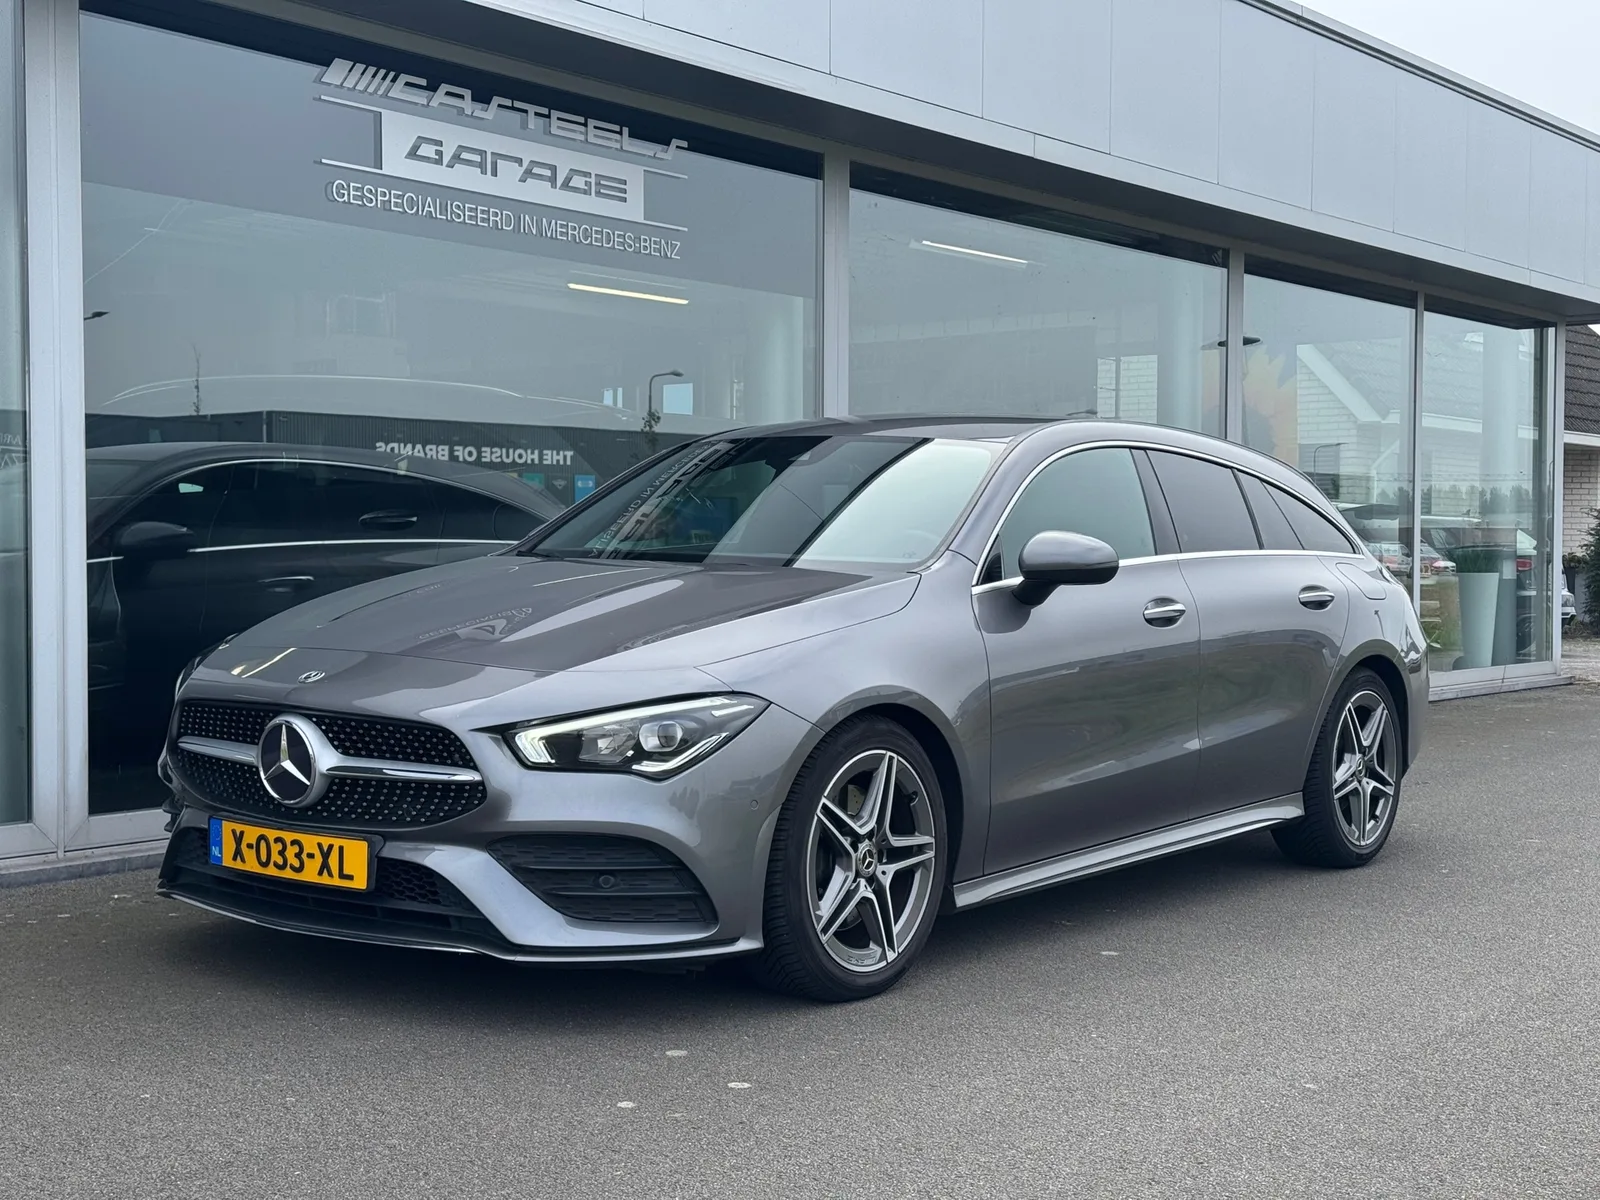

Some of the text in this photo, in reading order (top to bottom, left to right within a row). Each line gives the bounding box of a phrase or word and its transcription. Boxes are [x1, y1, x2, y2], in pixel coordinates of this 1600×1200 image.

[387, 73, 689, 160] CASTEELS
[404, 135, 628, 203] GARAGE
[332, 179, 681, 260] GESPECIALISEERD IN MERCEDES-BENZ
[211, 828, 354, 881] NL X-033-XL
